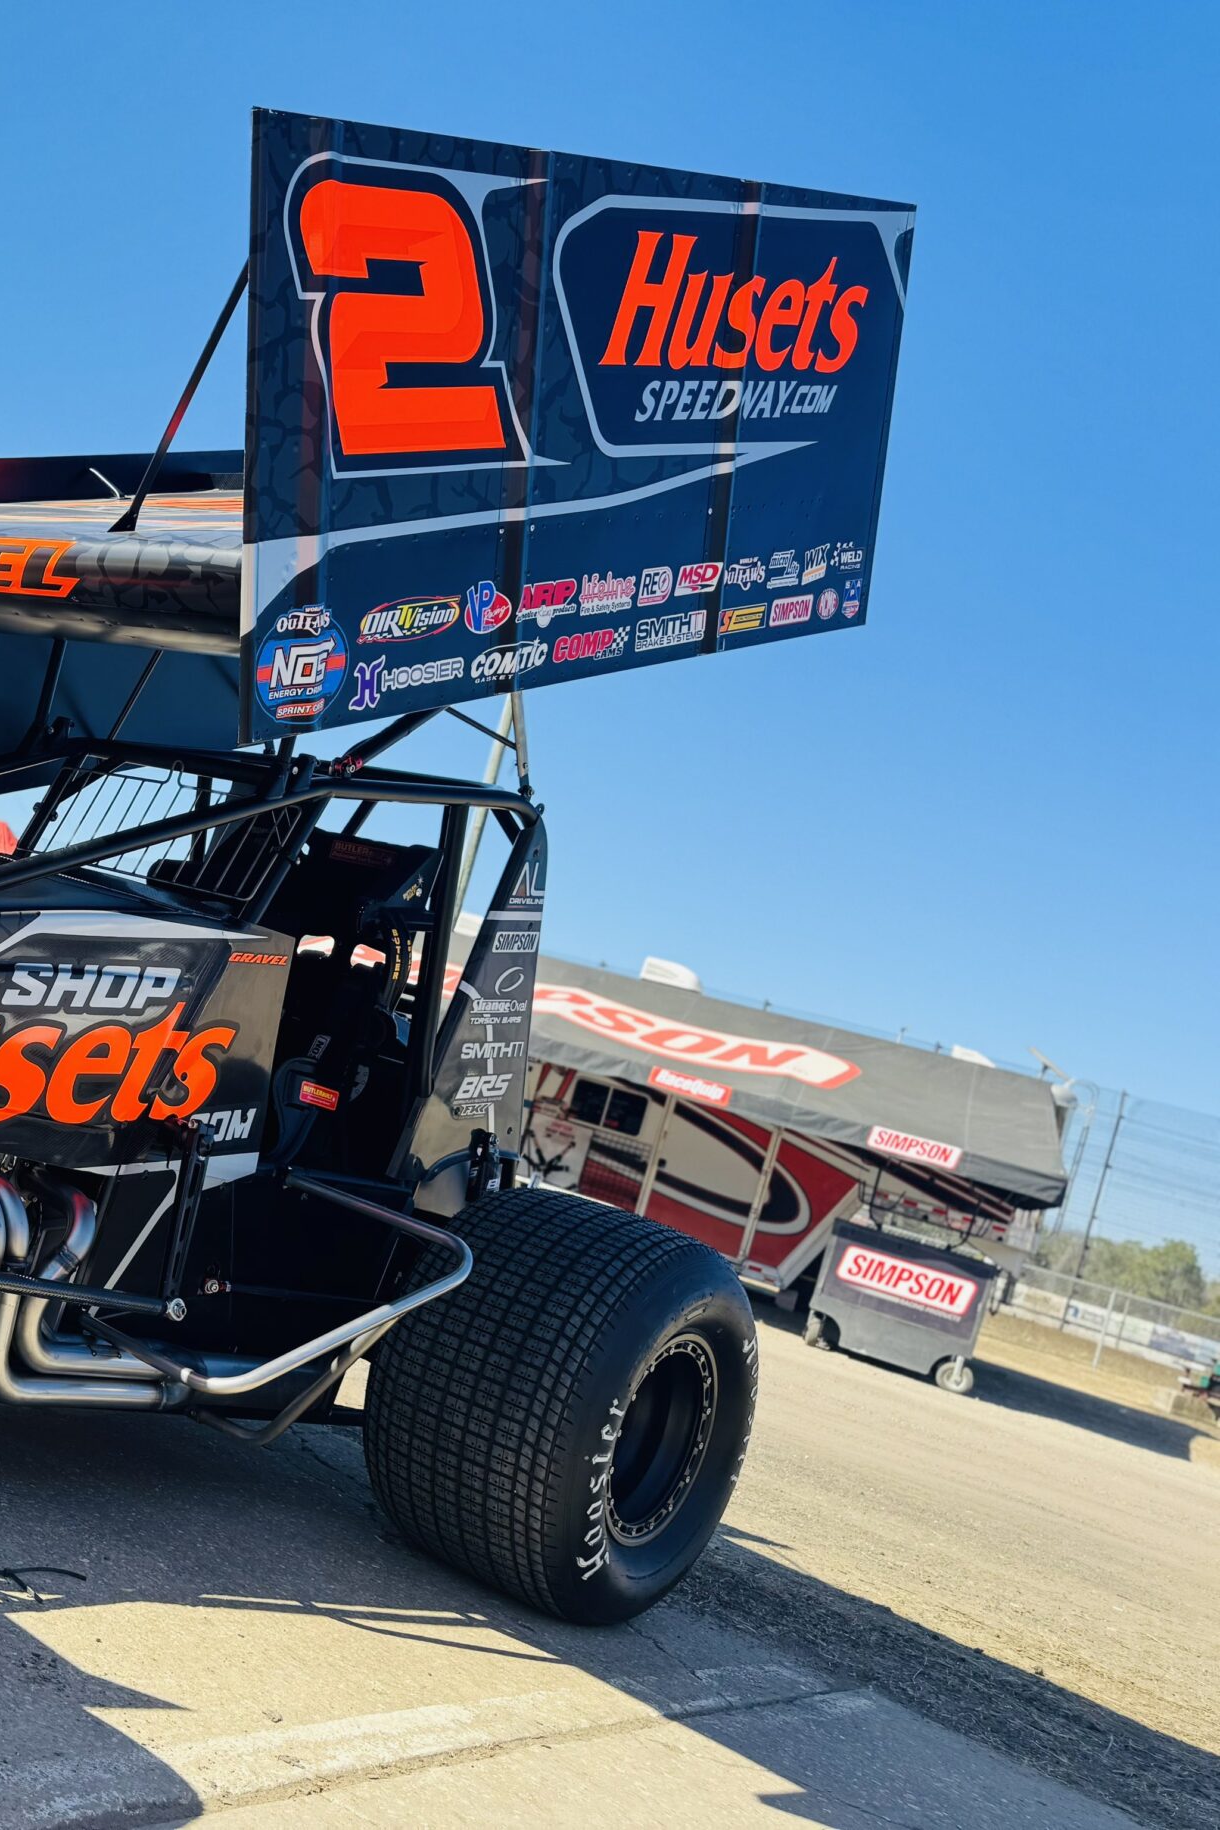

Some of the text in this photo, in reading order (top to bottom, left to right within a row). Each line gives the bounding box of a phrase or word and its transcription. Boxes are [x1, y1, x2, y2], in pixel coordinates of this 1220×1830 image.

[599, 230, 868, 372] Husets
[299, 179, 506, 455] 2
[805, 543, 830, 571] WIX
[840, 550, 862, 563] WELD
[678, 565, 719, 586] MSD
[467, 581, 496, 632] VP
[519, 579, 577, 612] ARP
[773, 600, 810, 622] SIMPSON
[553, 629, 614, 663] COMP
[594, 646, 623, 660] CAMS
[636, 630, 704, 650] BRAKE SYSTEMS
[269, 636, 336, 690] NOS
[381, 657, 464, 692] HOOSIER
[475, 674, 513, 683] GASKET
[268, 687, 304, 700] ENERGY
[277, 705, 312, 716] SPRINT
[495, 933, 537, 951] SIMPSON
[228, 952, 288, 967] GRAVEL
[1, 963, 181, 1009] SHOP
[470, 1016, 522, 1025] TORSION BARS
[455, 1073, 513, 1100] BRS
[655, 1069, 725, 1100] RaceQuip
[874, 1130, 953, 1162] SIMPSON
[848, 1253, 964, 1306] SIMPSON
[576, 1398, 626, 1581] Hoosier
